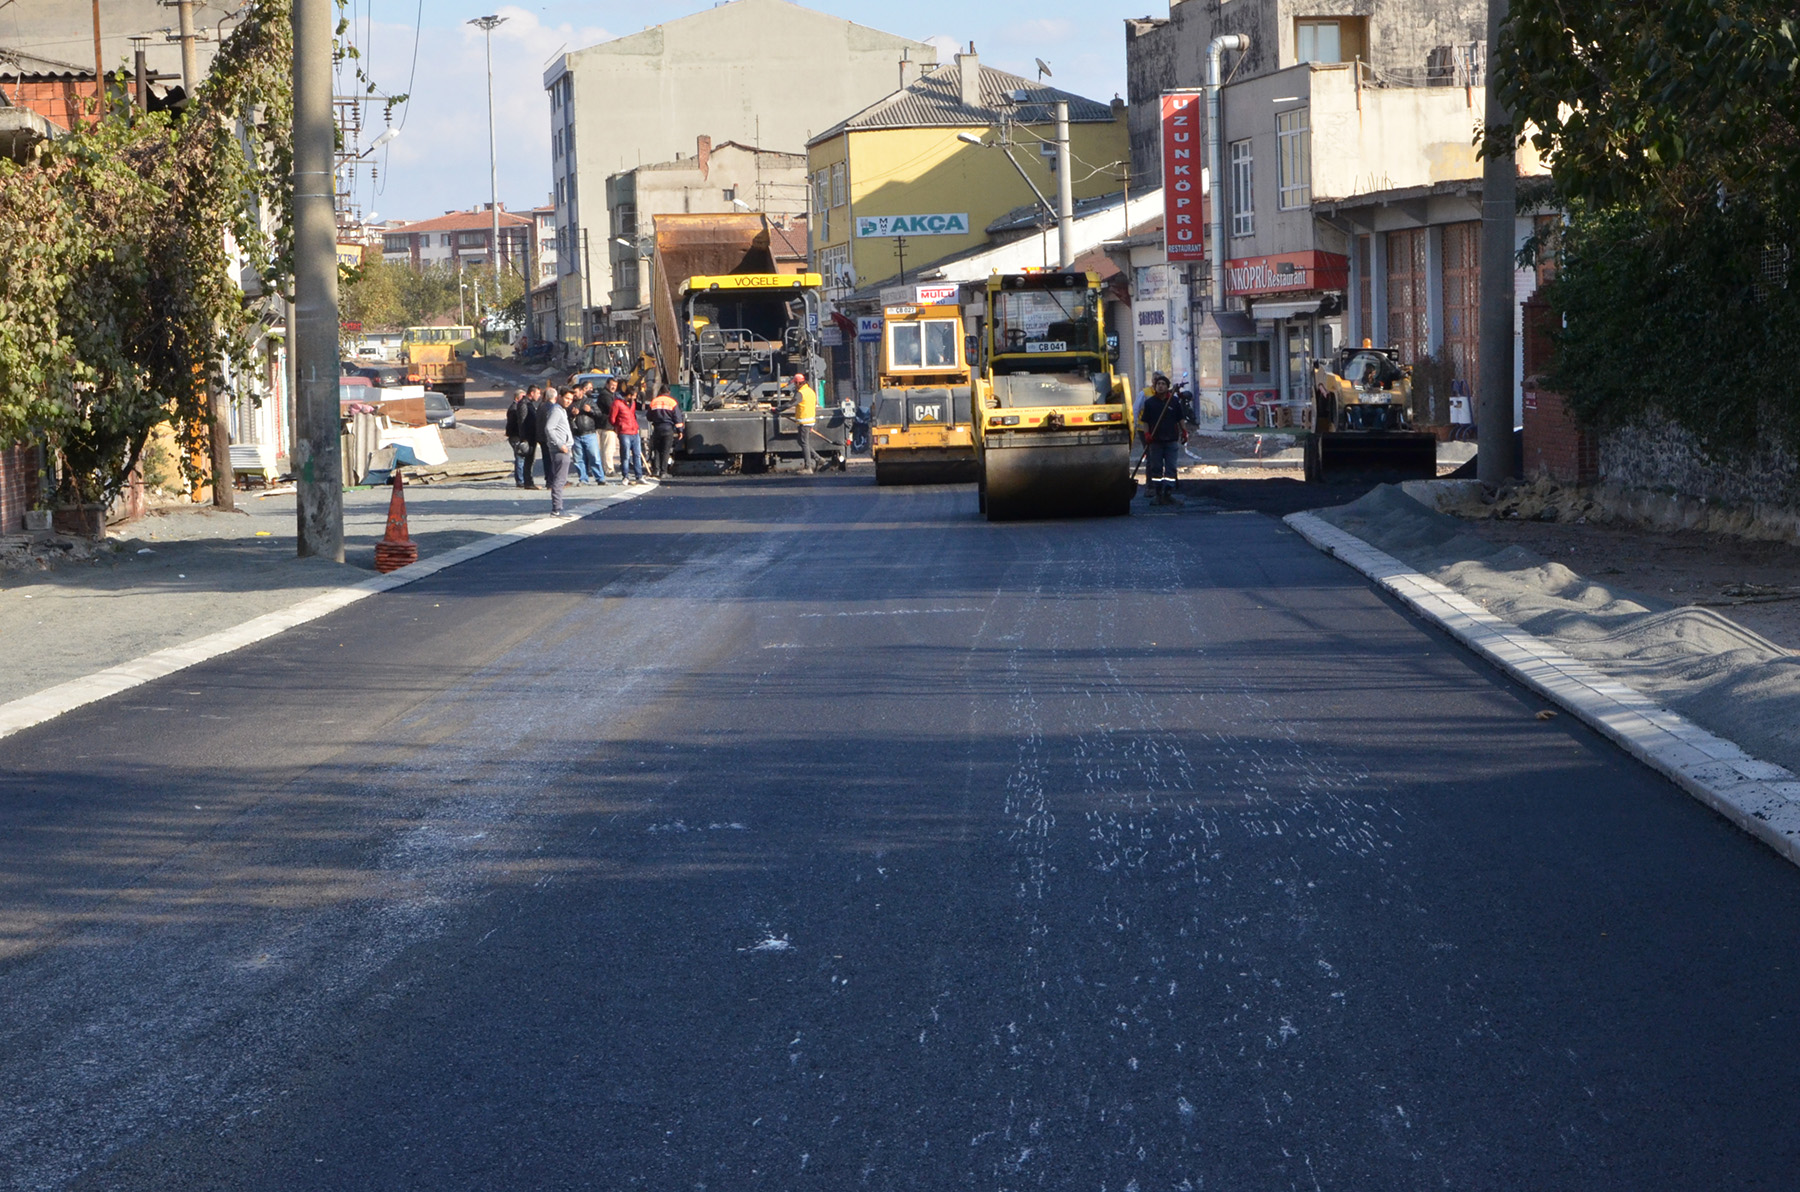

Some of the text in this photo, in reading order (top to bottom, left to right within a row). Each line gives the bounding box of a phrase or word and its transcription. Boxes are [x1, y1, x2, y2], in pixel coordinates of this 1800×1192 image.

[1173, 99, 1193, 241] UZUNKÖPRÜ
[890, 215, 965, 234] AKÇA
[1168, 243, 1202, 253] RESTAURANT
[734, 276, 779, 287] VÖGELE
[921, 288, 955, 299] MUTLU
[1050, 343, 1064, 351] 041
[915, 405, 941, 421] CAT
